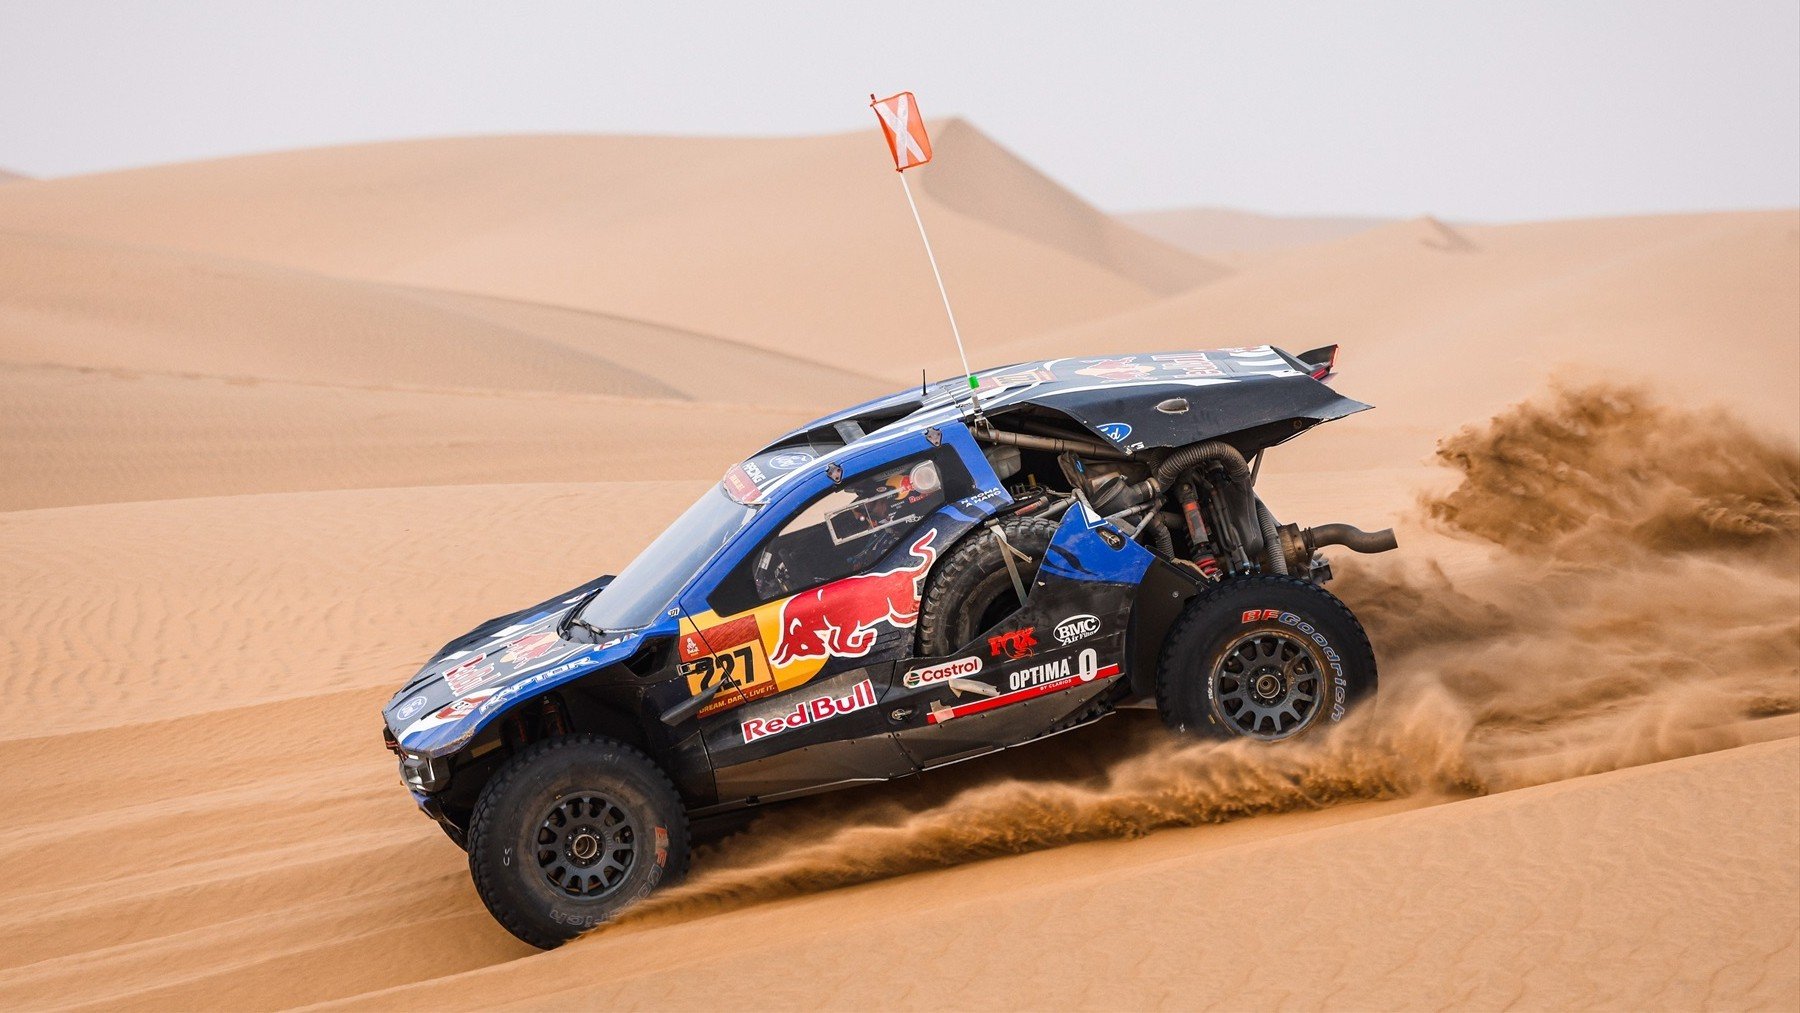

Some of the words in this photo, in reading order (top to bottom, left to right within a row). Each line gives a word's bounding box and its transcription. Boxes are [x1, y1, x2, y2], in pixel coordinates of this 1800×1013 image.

[970, 487, 999, 500] ROMA
[973, 490, 1001, 504] HARO
[1057, 617, 1097, 640] BMC
[921, 660, 979, 682] Castrol
[1009, 658, 1070, 691] OPTIMA
[1241, 609, 1347, 722] BFGoodrich
[741, 702, 808, 744] Red
[809, 678, 878, 724] Bull
